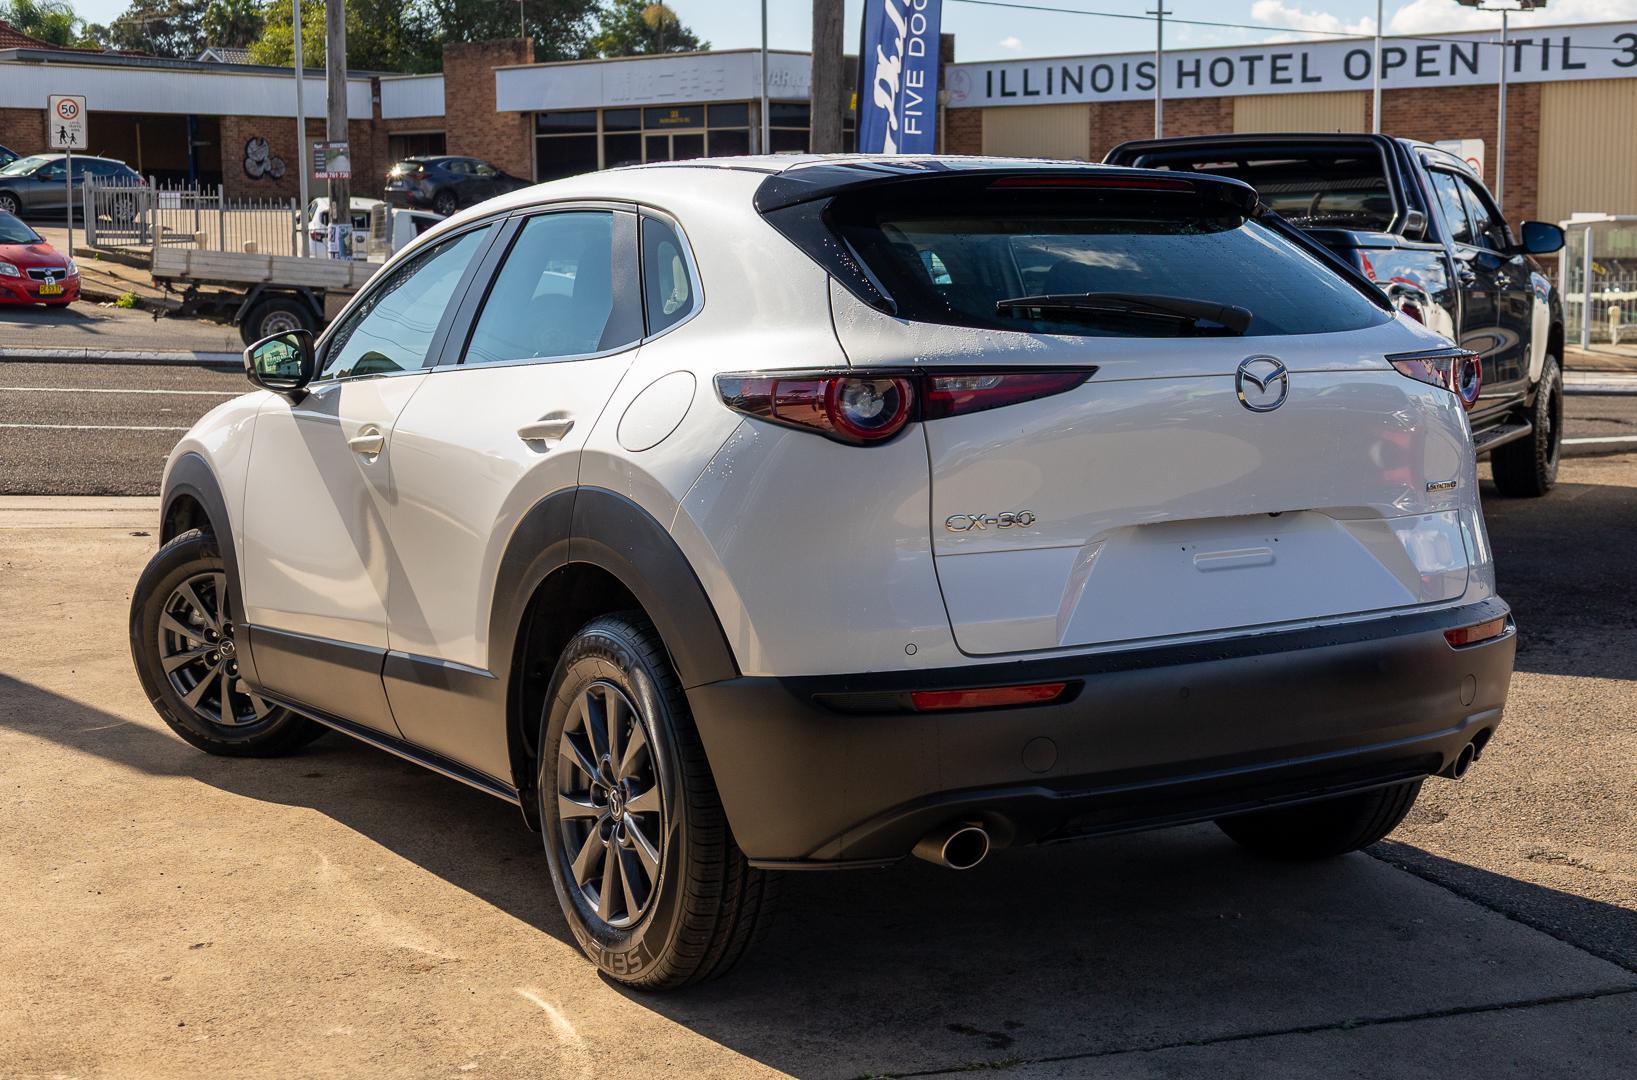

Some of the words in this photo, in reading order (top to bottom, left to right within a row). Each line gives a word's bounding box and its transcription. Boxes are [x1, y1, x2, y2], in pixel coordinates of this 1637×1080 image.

[986, 61, 1157, 98] ILLINOIS
[1176, 52, 1322, 88] HOTEL
[1344, 42, 1479, 81] OPEN
[1504, 36, 1586, 73] TIL
[61, 104, 76, 115] 50
[904, 69, 924, 135] FIVE
[945, 509, 1036, 532] CX-30
